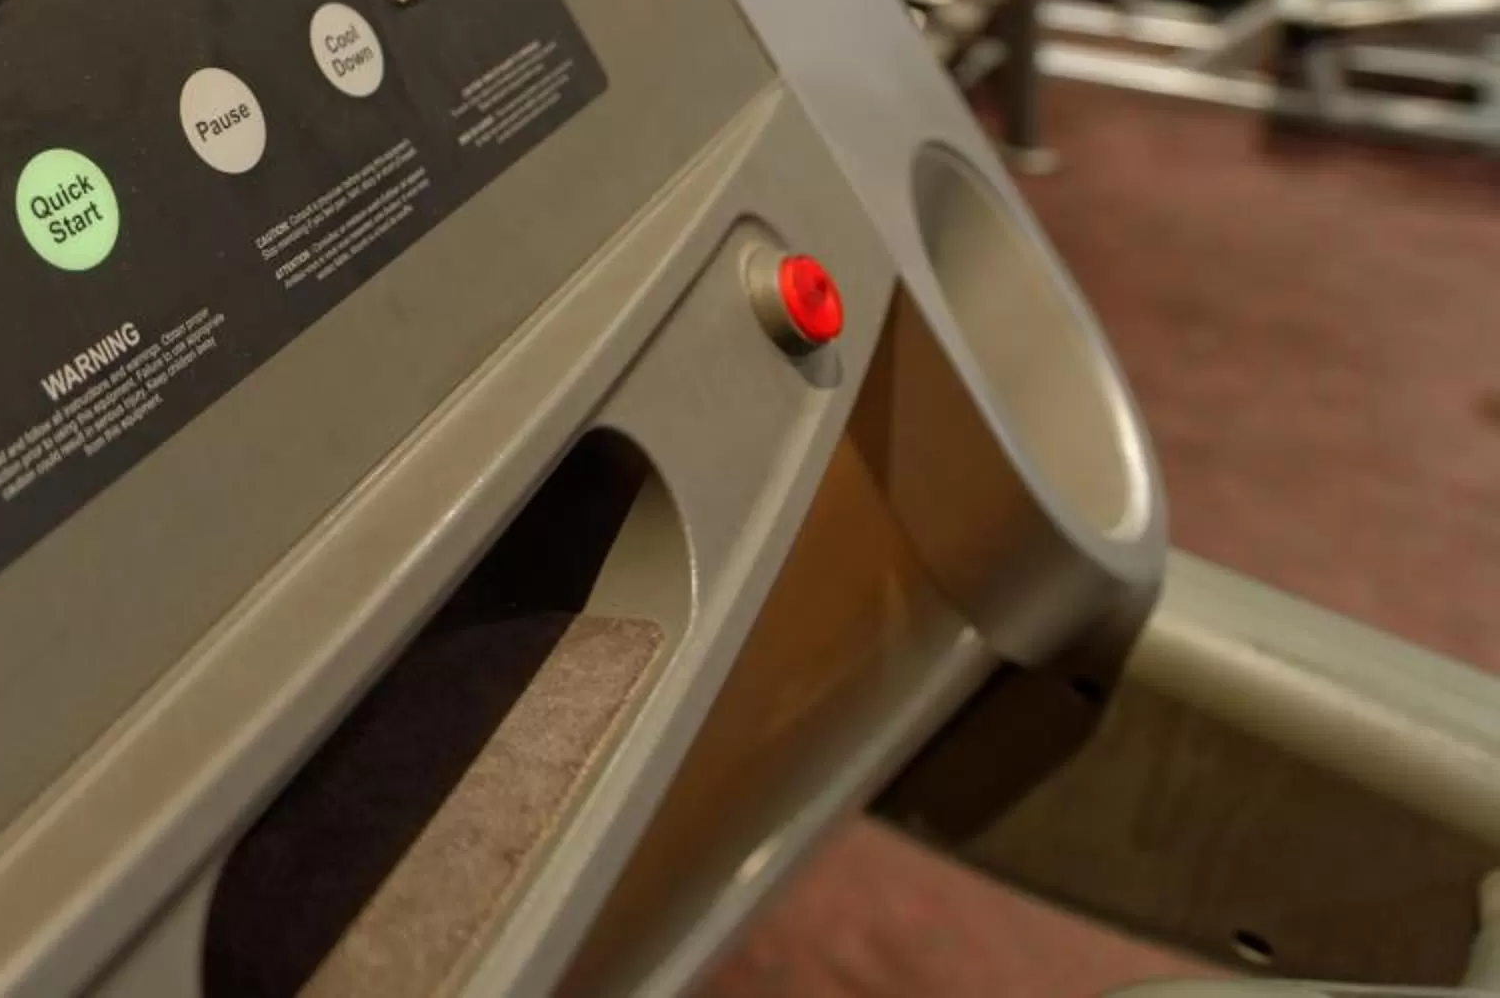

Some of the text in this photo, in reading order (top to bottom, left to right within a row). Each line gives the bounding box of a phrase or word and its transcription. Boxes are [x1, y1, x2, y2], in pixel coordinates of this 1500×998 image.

[325, 24, 361, 55] Cool
[331, 45, 374, 79] Down
[195, 102, 252, 143] Pause
[30, 174, 95, 221] Quick
[48, 201, 104, 245] Start
[40, 321, 141, 402] WARNING
